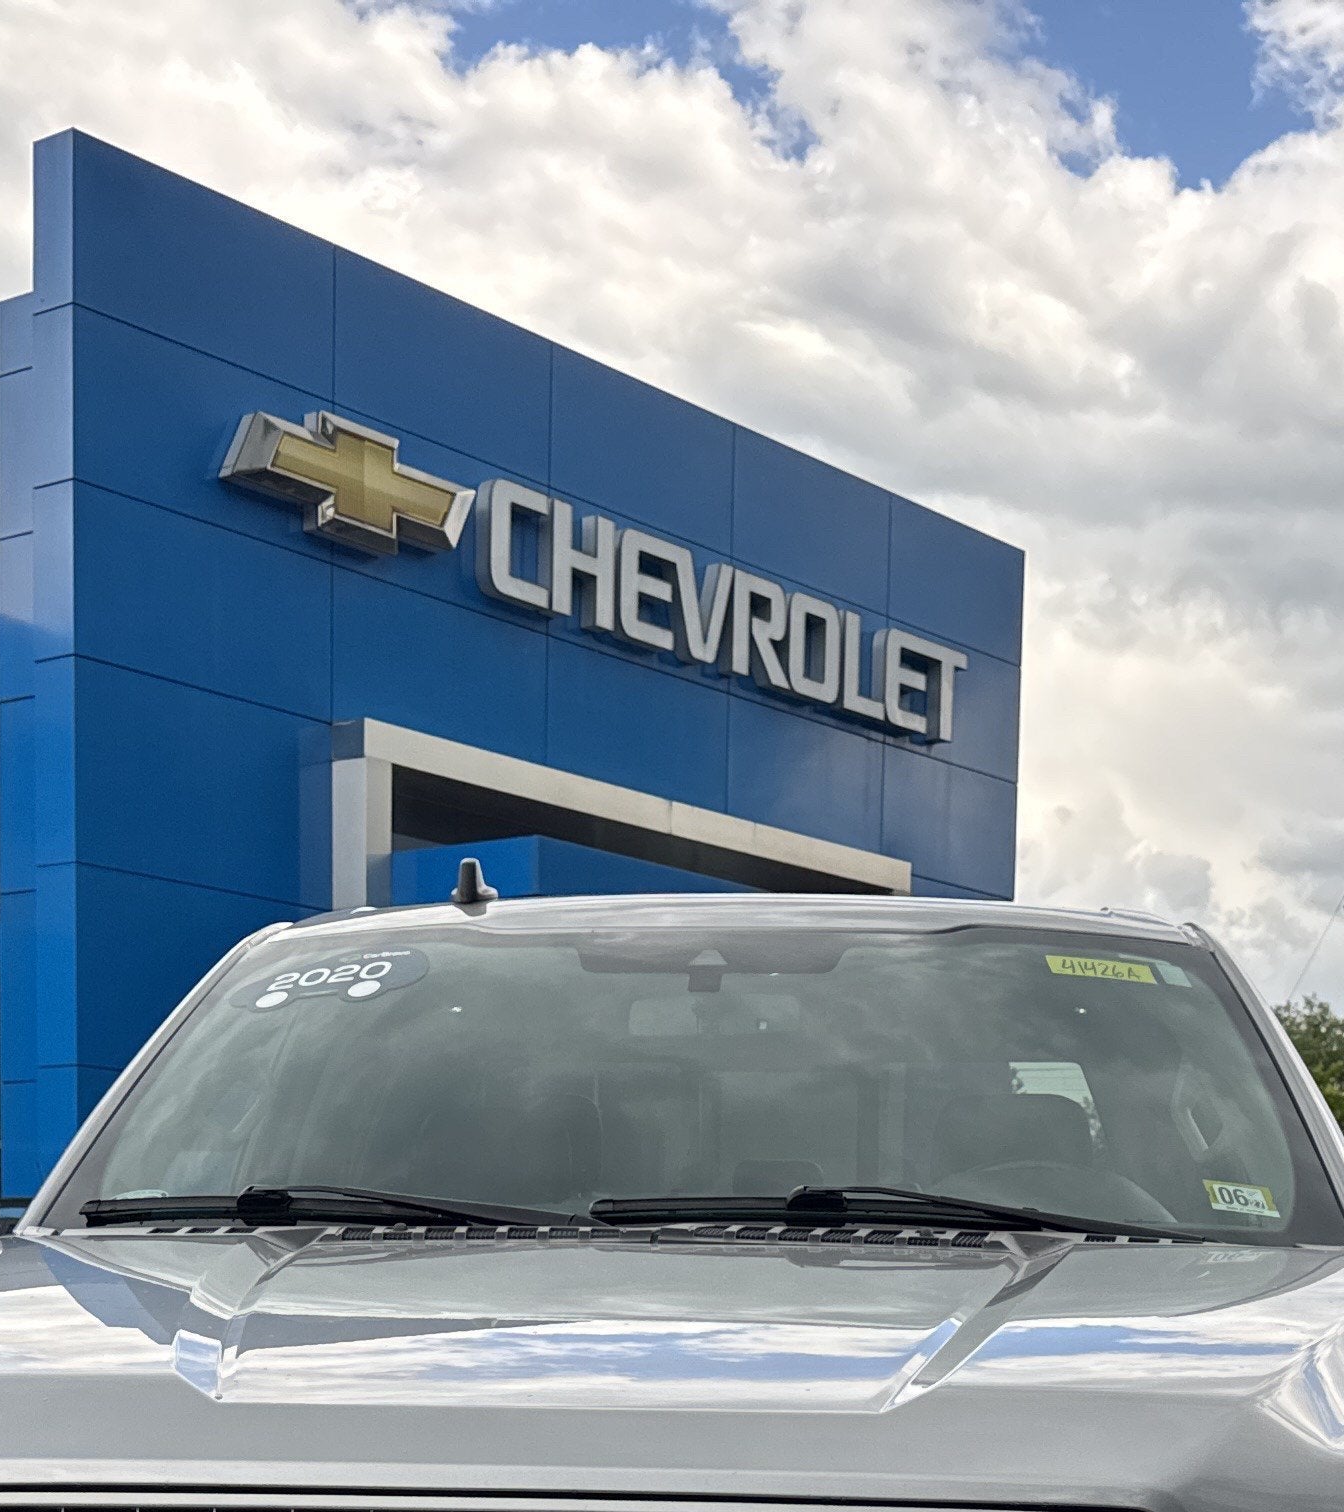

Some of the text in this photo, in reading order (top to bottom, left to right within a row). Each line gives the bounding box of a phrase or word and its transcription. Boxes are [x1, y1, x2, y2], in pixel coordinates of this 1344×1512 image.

[476, 479, 968, 743] CHEVROLET
[266, 961, 392, 991] 2020
[1218, 1186, 1249, 1207] 06
